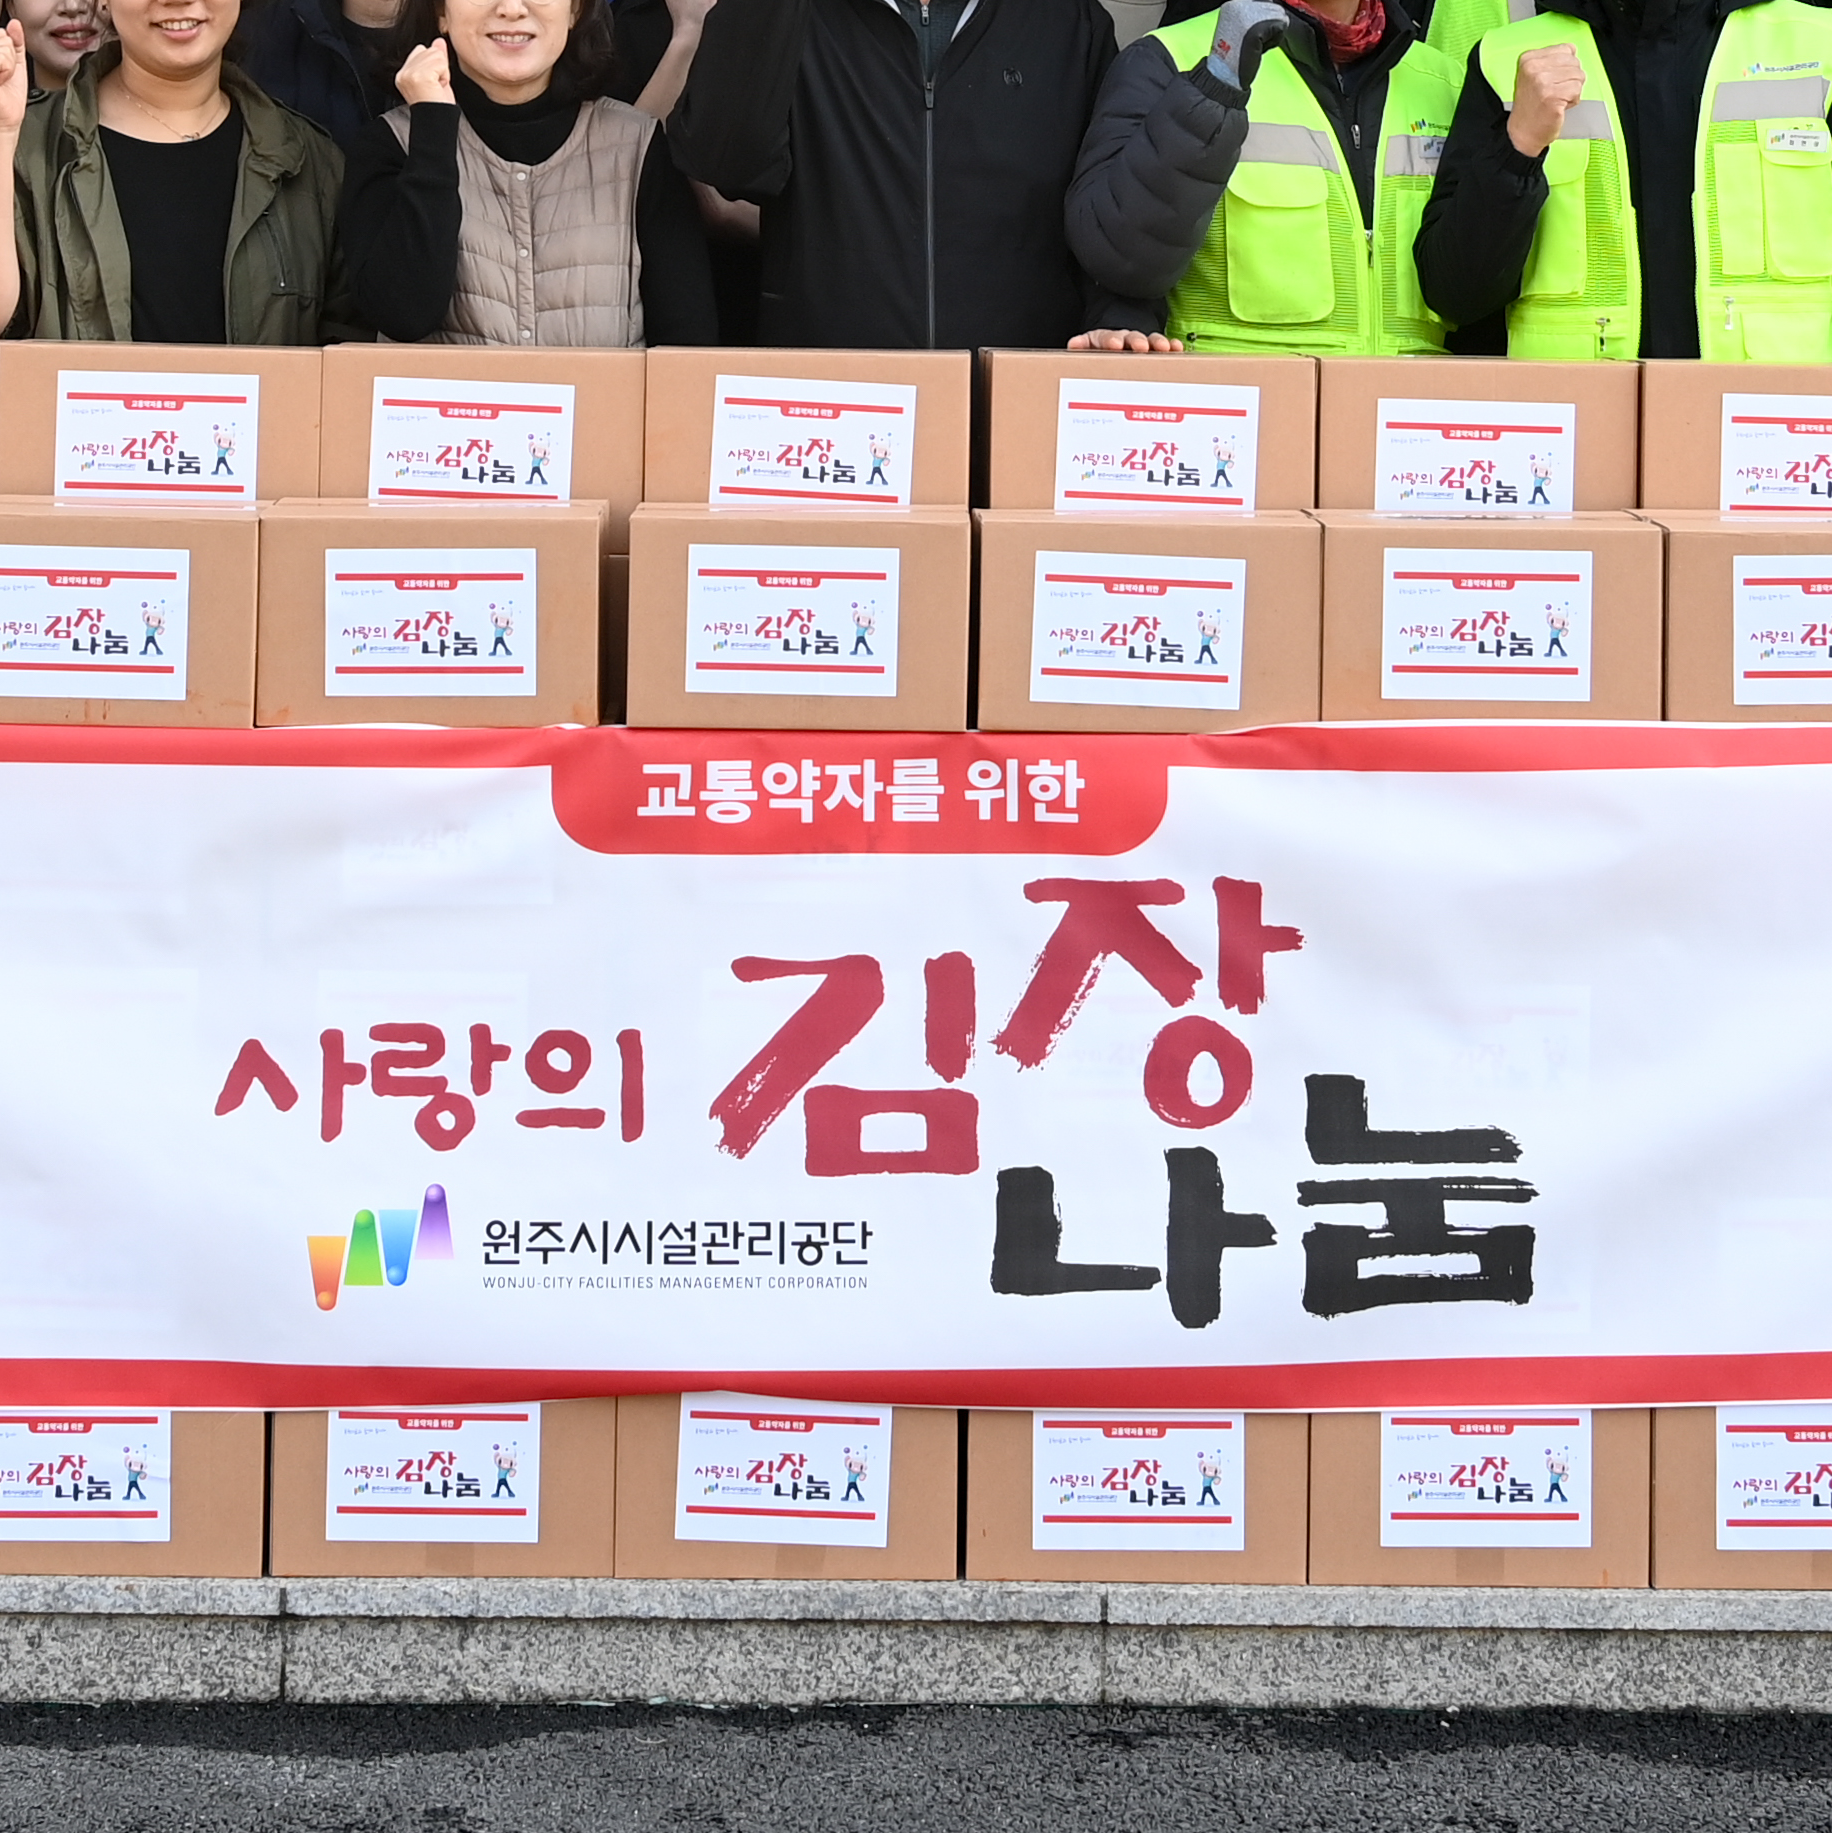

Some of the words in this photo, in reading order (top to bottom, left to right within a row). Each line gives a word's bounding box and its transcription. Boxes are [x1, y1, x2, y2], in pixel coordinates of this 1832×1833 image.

[72, 443, 114, 456] 사랑의
[120, 430, 179, 460] 김장
[728, 448, 770, 462] 사랑의
[776, 437, 834, 468] 김장
[147, 450, 201, 475] 나눔
[802, 458, 856, 484] 나눔
[1391, 472, 1433, 486] 사랑의
[1439, 459, 1496, 490] 김장
[1465, 480, 1518, 505] 나눔
[342, 626, 387, 639] 사랑의
[393, 611, 454, 642] 김장
[1050, 627, 1094, 642] 사랑의
[1100, 615, 1161, 647] 김장
[1750, 630, 1794, 644] 사랑의
[421, 631, 478, 657] 나눔
[1127, 637, 1184, 664] 나눔
[637, 758, 946, 824] 교통약자를
[964, 758, 1086, 823] 위한
[215, 1022, 645, 1152] 사랑의
[710, 875, 1305, 1178] 김장
[992, 1073, 1540, 1329] 나눔
[482, 1219, 874, 1267] 원주시시설관리공단
[482, 1276, 573, 1289] WONJU-CITY
[579, 1276, 654, 1289] FACILITIES
[659, 1276, 763, 1289] MANAGEMENT
[768, 1276, 867, 1289] CORPORATION
[26, 1454, 87, 1486] 김장
[695, 1465, 740, 1479] 사랑의
[746, 1452, 807, 1485] 김장
[1398, 1471, 1442, 1485] 사랑의
[1449, 1456, 1510, 1488] 김장
[54, 1475, 112, 1501] 나눔
[773, 1474, 831, 1501] 나눔
[1477, 1477, 1533, 1504] 나눔
